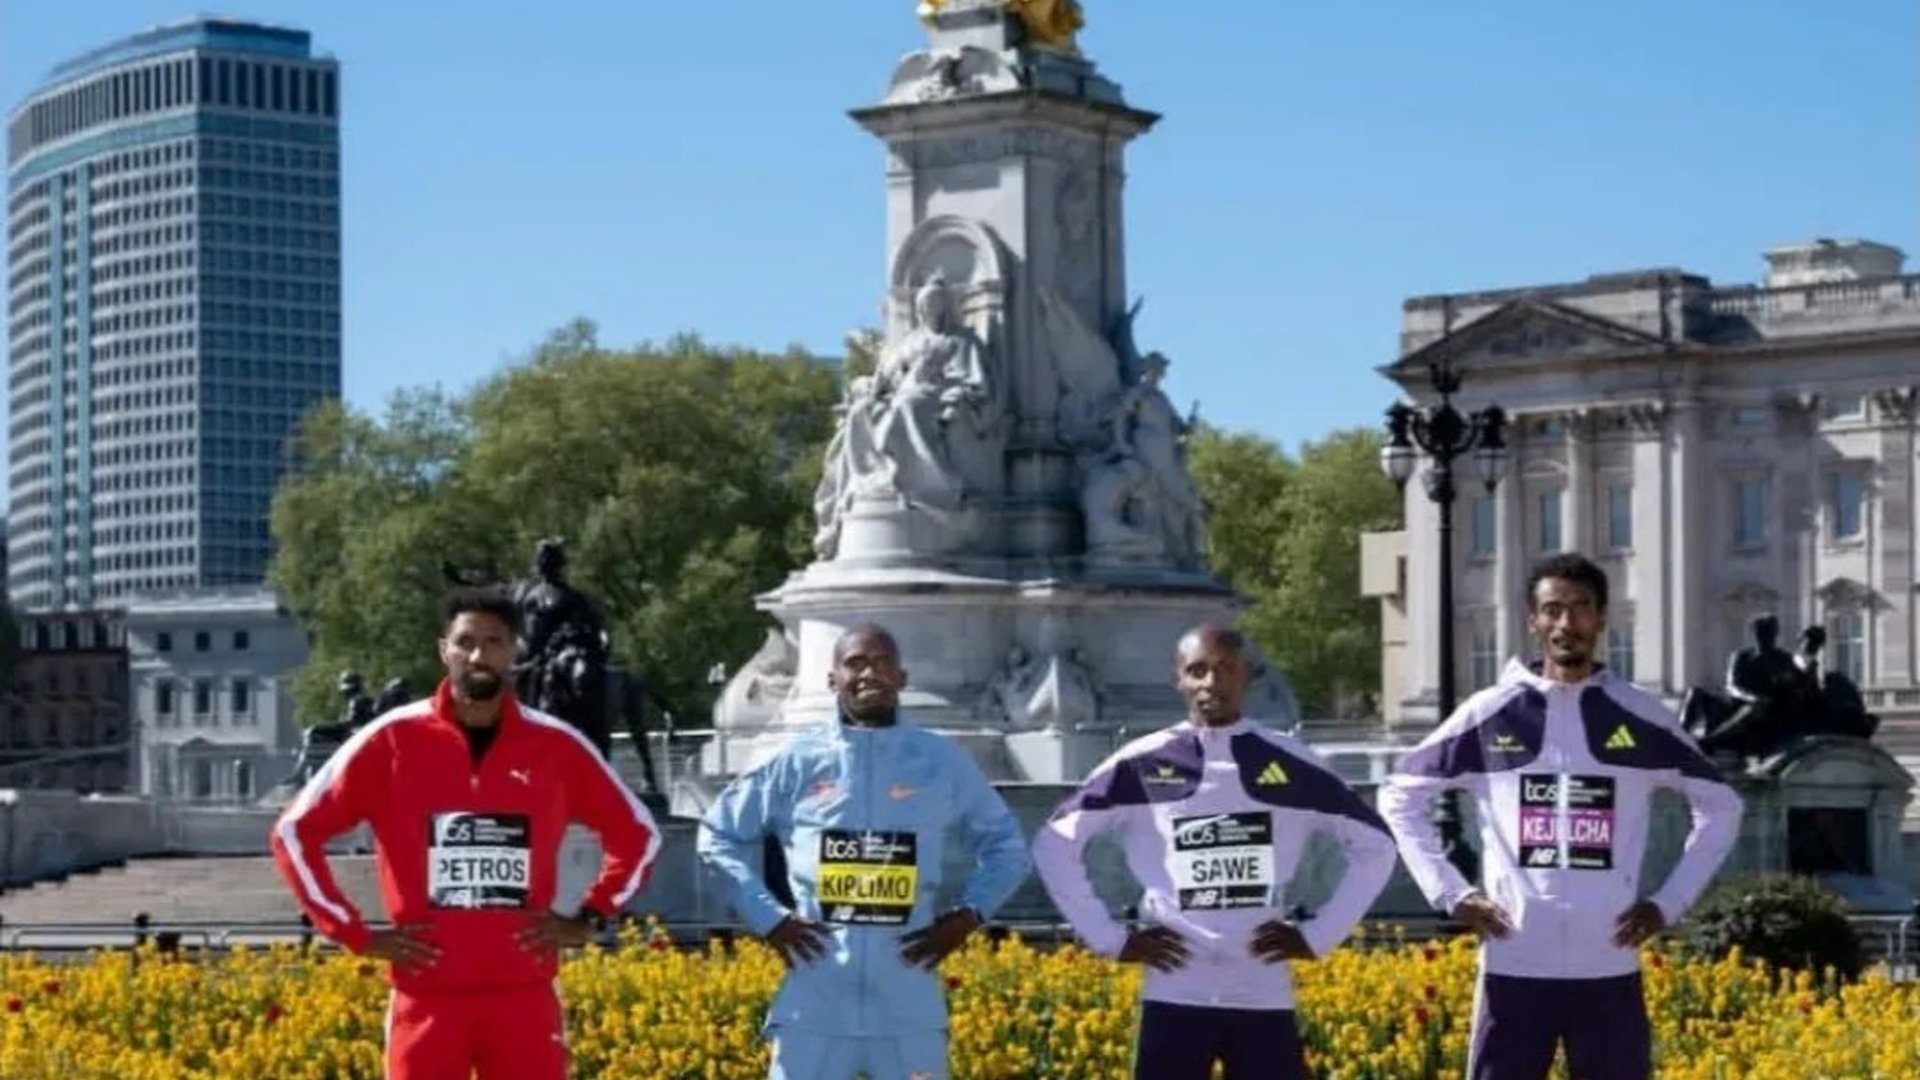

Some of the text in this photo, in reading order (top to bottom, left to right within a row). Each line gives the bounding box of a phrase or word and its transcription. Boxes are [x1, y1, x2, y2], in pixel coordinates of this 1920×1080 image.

[1522, 815, 1610, 842] KEJLCHA
[438, 858, 525, 882] PETROS
[1191, 857, 1260, 883] SAWE
[822, 874, 911, 899] KIPLIMO
